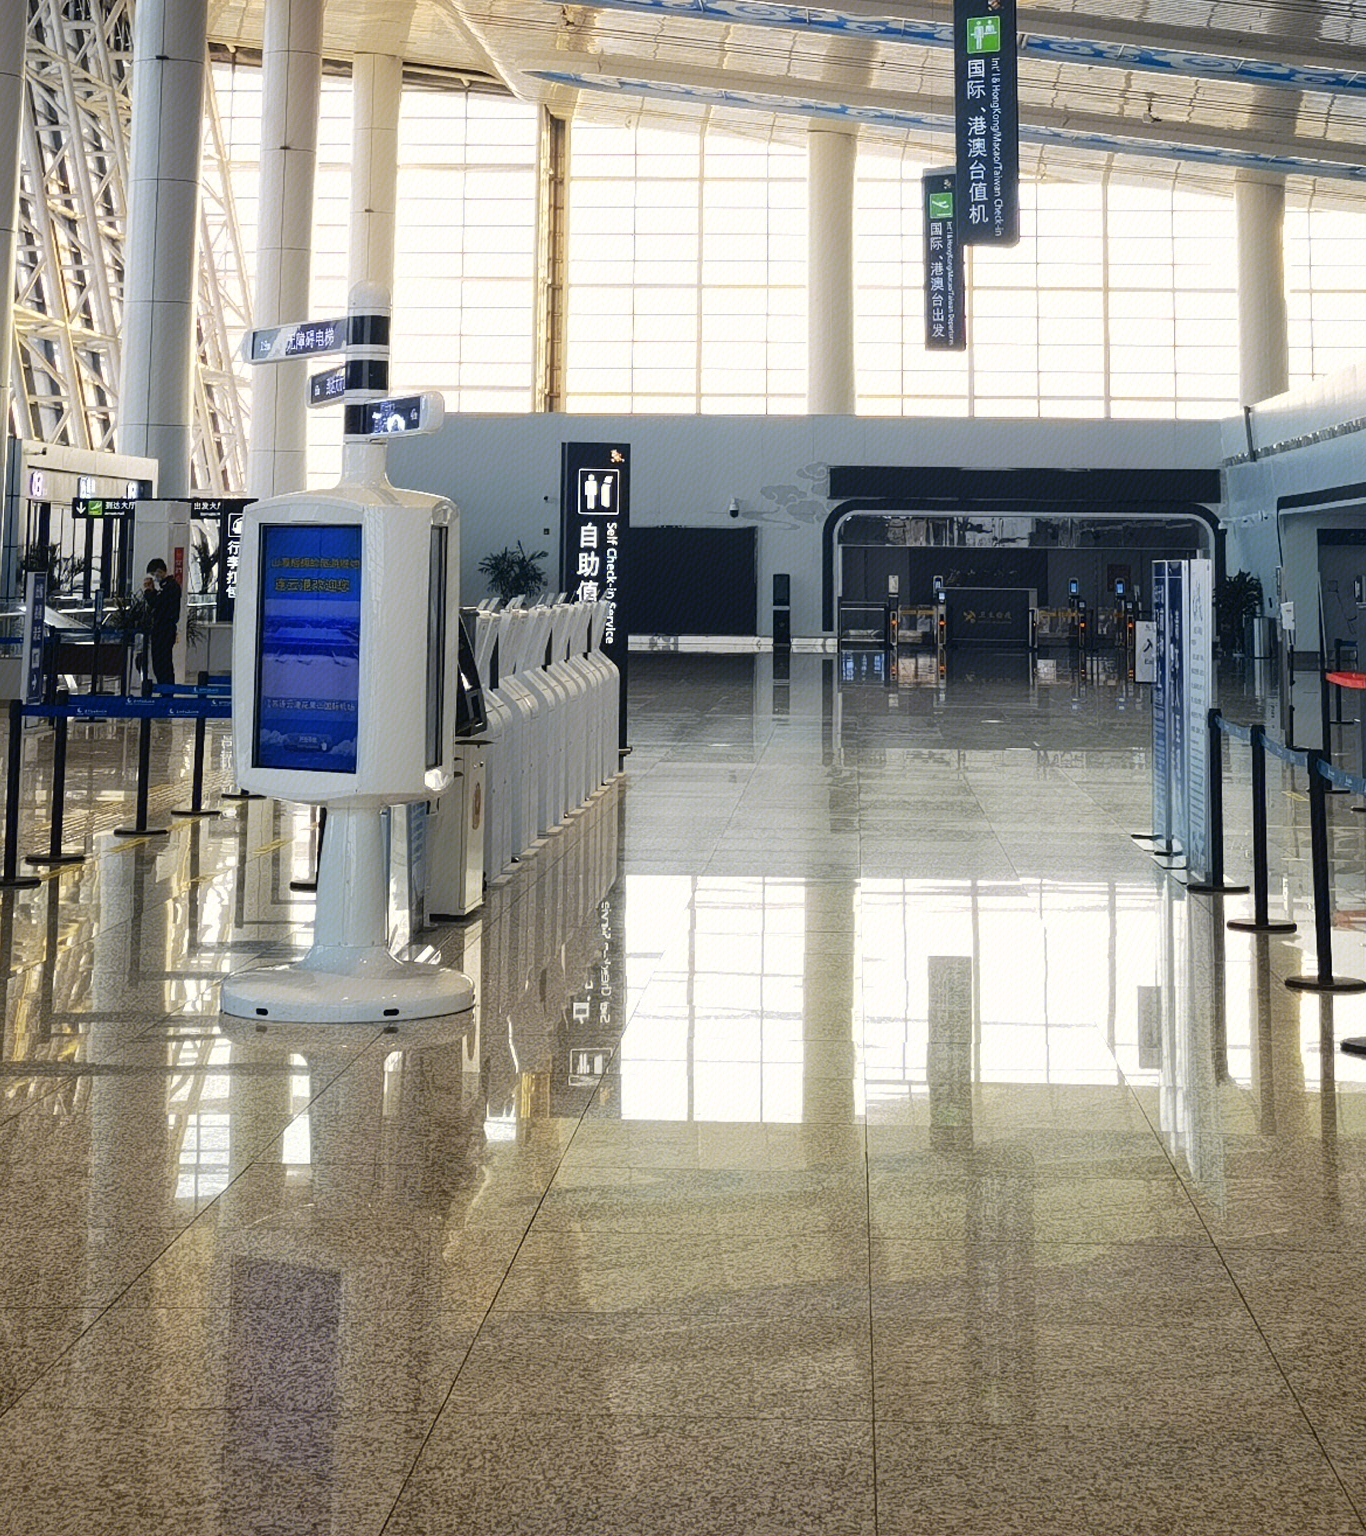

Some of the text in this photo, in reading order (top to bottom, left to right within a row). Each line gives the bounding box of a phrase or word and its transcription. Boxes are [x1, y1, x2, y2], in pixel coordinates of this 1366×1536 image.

[967, 59, 989, 224] 国际、港澳台值机
[993, 199, 1004, 237] Check-in
[930, 222, 945, 337] 国际、港澳台出发
[606, 522, 618, 545] Self
[606, 548, 618, 600] Check-in
